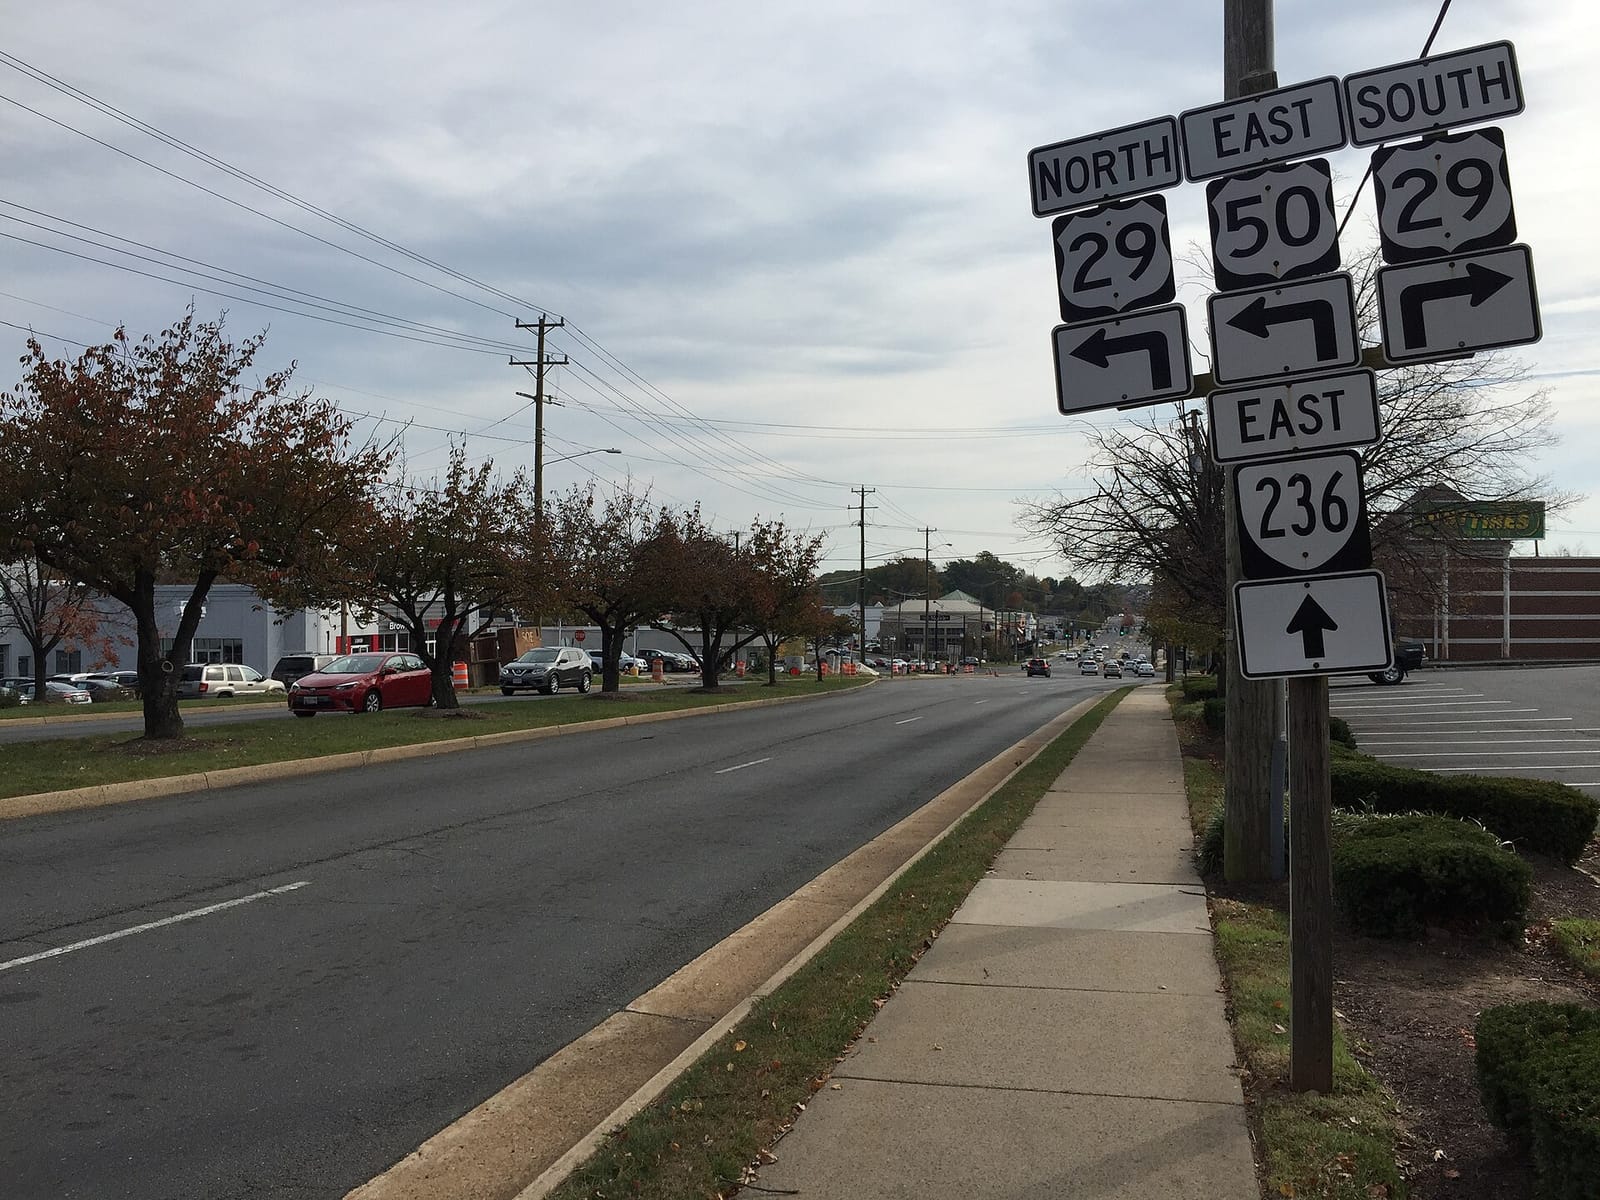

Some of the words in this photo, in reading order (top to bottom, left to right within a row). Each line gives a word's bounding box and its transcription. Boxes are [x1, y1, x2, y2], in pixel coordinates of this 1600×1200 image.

[1212, 98, 1314, 160] EAST
[1356, 61, 1511, 129] SOUTH
[1038, 134, 1172, 202] NORTH
[1391, 158, 1495, 234] 29
[1225, 186, 1321, 258] 50
[1069, 222, 1157, 293] 29
[1237, 390, 1346, 444] EAST
[1256, 470, 1349, 540] 236
